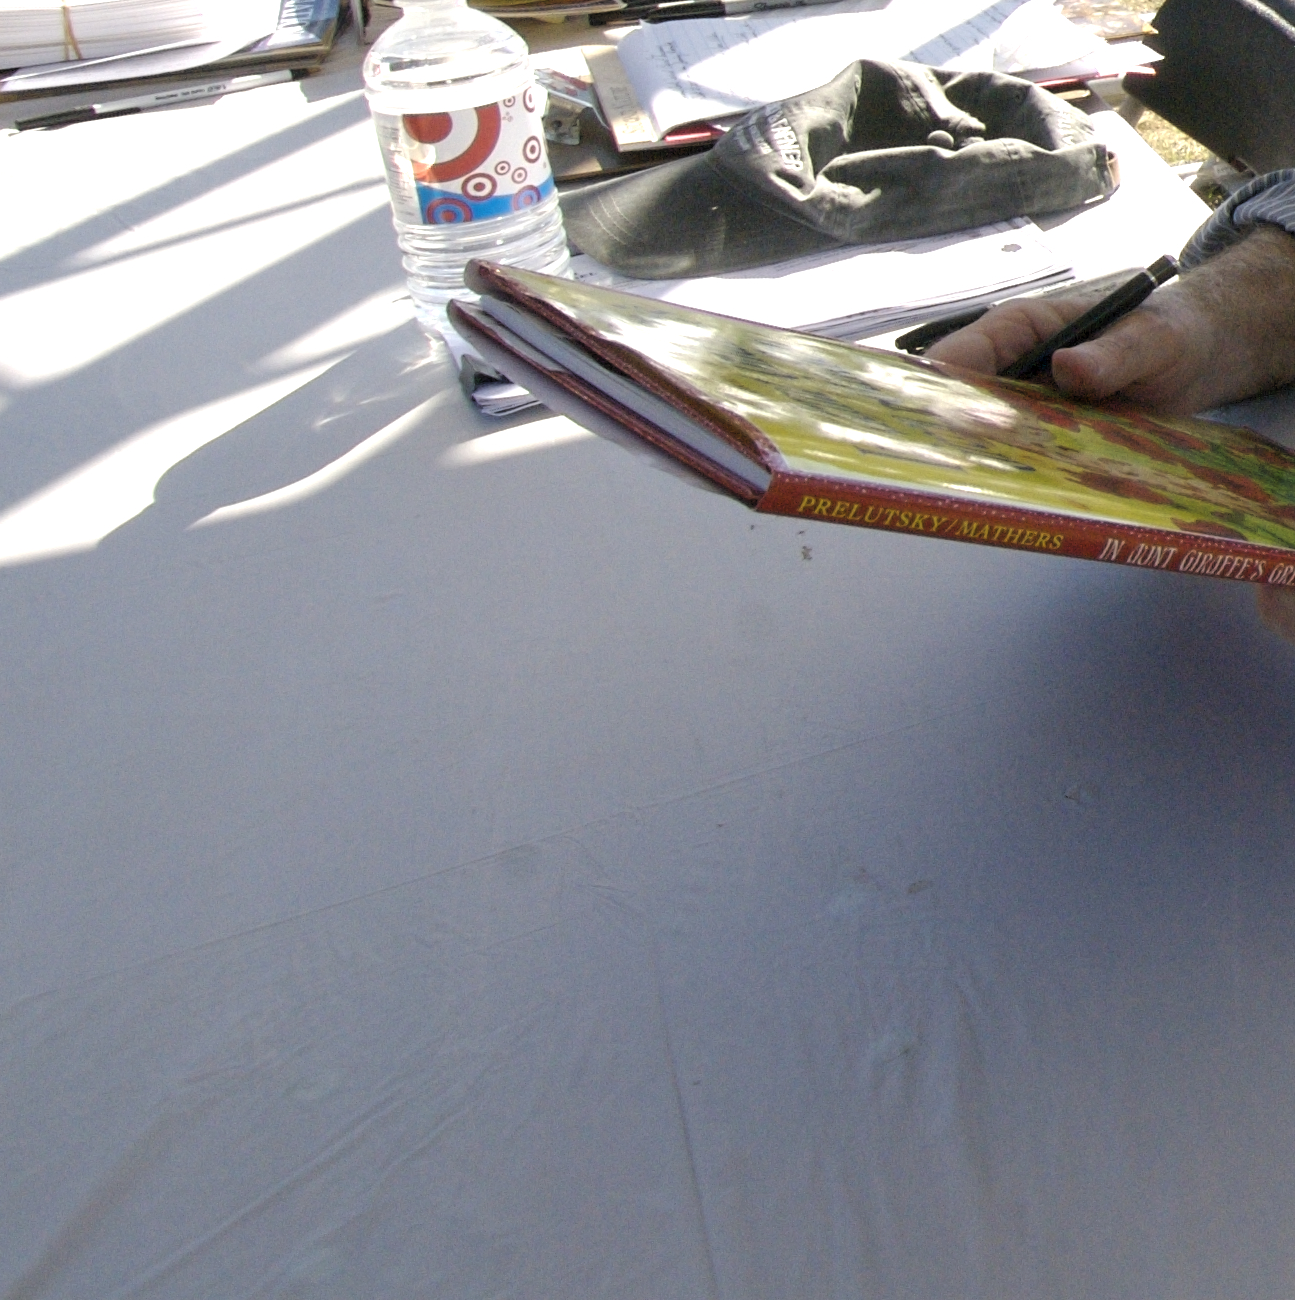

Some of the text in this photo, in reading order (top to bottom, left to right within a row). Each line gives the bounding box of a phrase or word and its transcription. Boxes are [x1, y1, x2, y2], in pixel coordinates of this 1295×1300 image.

[799, 496, 1064, 550] PRELUTSKY/MATHERS
[1100, 537, 1126, 562] IN
[1127, 542, 1178, 568] AUNT
[1179, 549, 1267, 582] GIRAFFE'S
